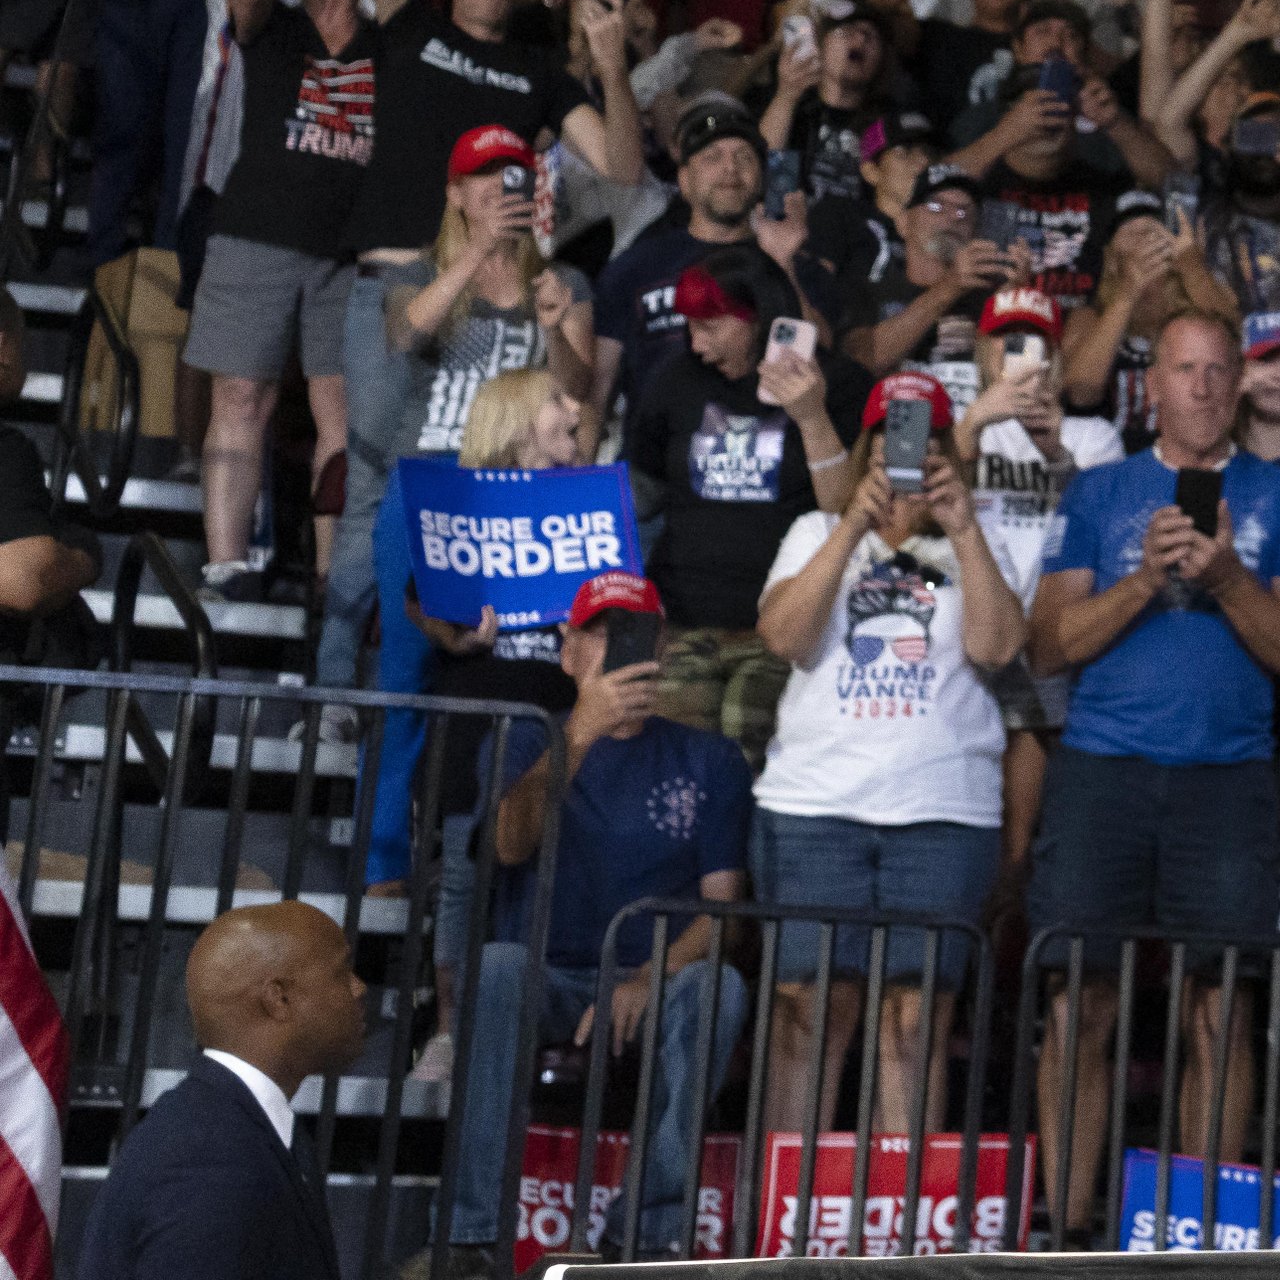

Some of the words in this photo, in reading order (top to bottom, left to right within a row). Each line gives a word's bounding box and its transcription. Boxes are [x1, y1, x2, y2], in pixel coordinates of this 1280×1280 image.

[418, 508, 534, 543] SECURE
[540, 510, 615, 539] OUR
[421, 533, 623, 578] BORDER
[837, 662, 937, 683] TRUMP
[1130, 1209, 1259, 1250] SCURE
